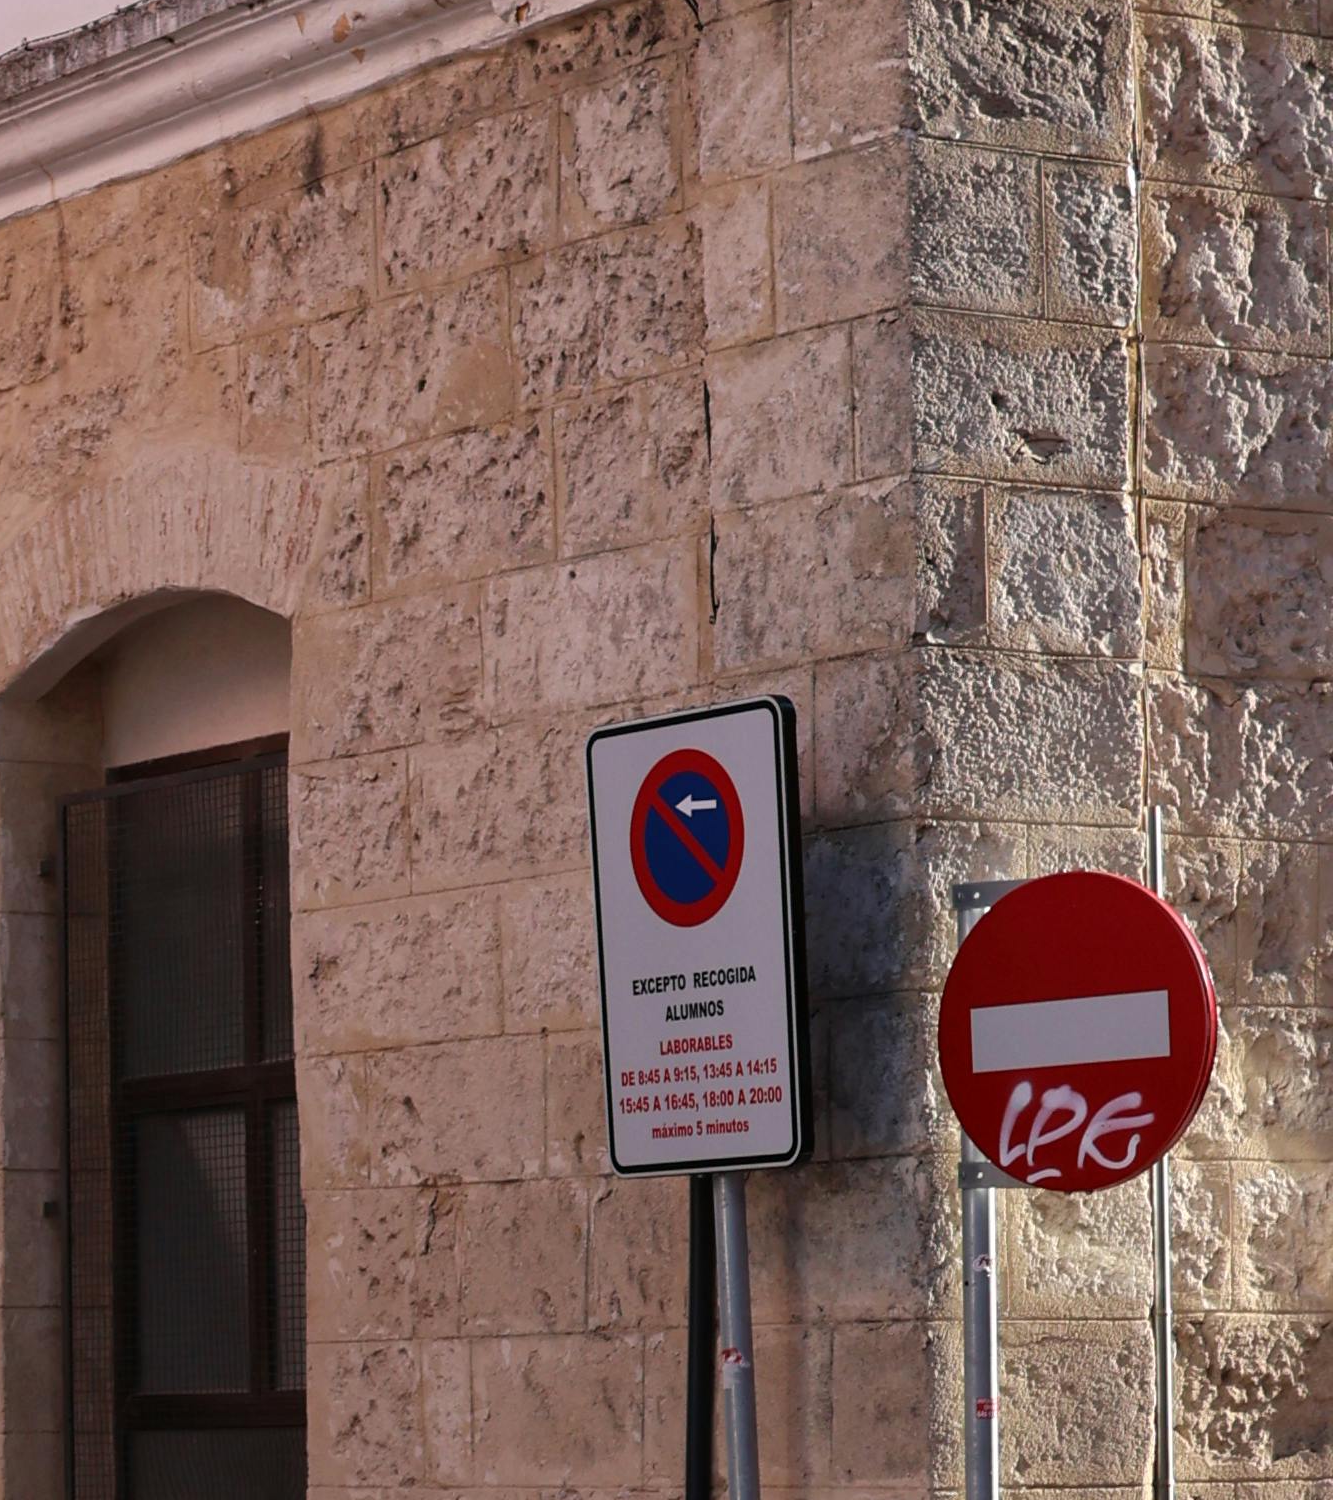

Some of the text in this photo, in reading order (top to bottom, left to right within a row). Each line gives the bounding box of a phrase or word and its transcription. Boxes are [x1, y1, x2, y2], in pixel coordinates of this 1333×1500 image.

[633, 966, 756, 995] EXCEPTO RECOGIDA
[666, 1000, 724, 1022] ALUMNOS
[660, 1034, 732, 1055] LABORABLES
[621, 1058, 777, 1086] DE 8:45 A 9:15, 13:45 A 14:15
[620, 1086, 782, 1114] 15:45 A 16:45, 18:00 A 20:00
[652, 1119, 749, 1139] máximo 5 minutos
